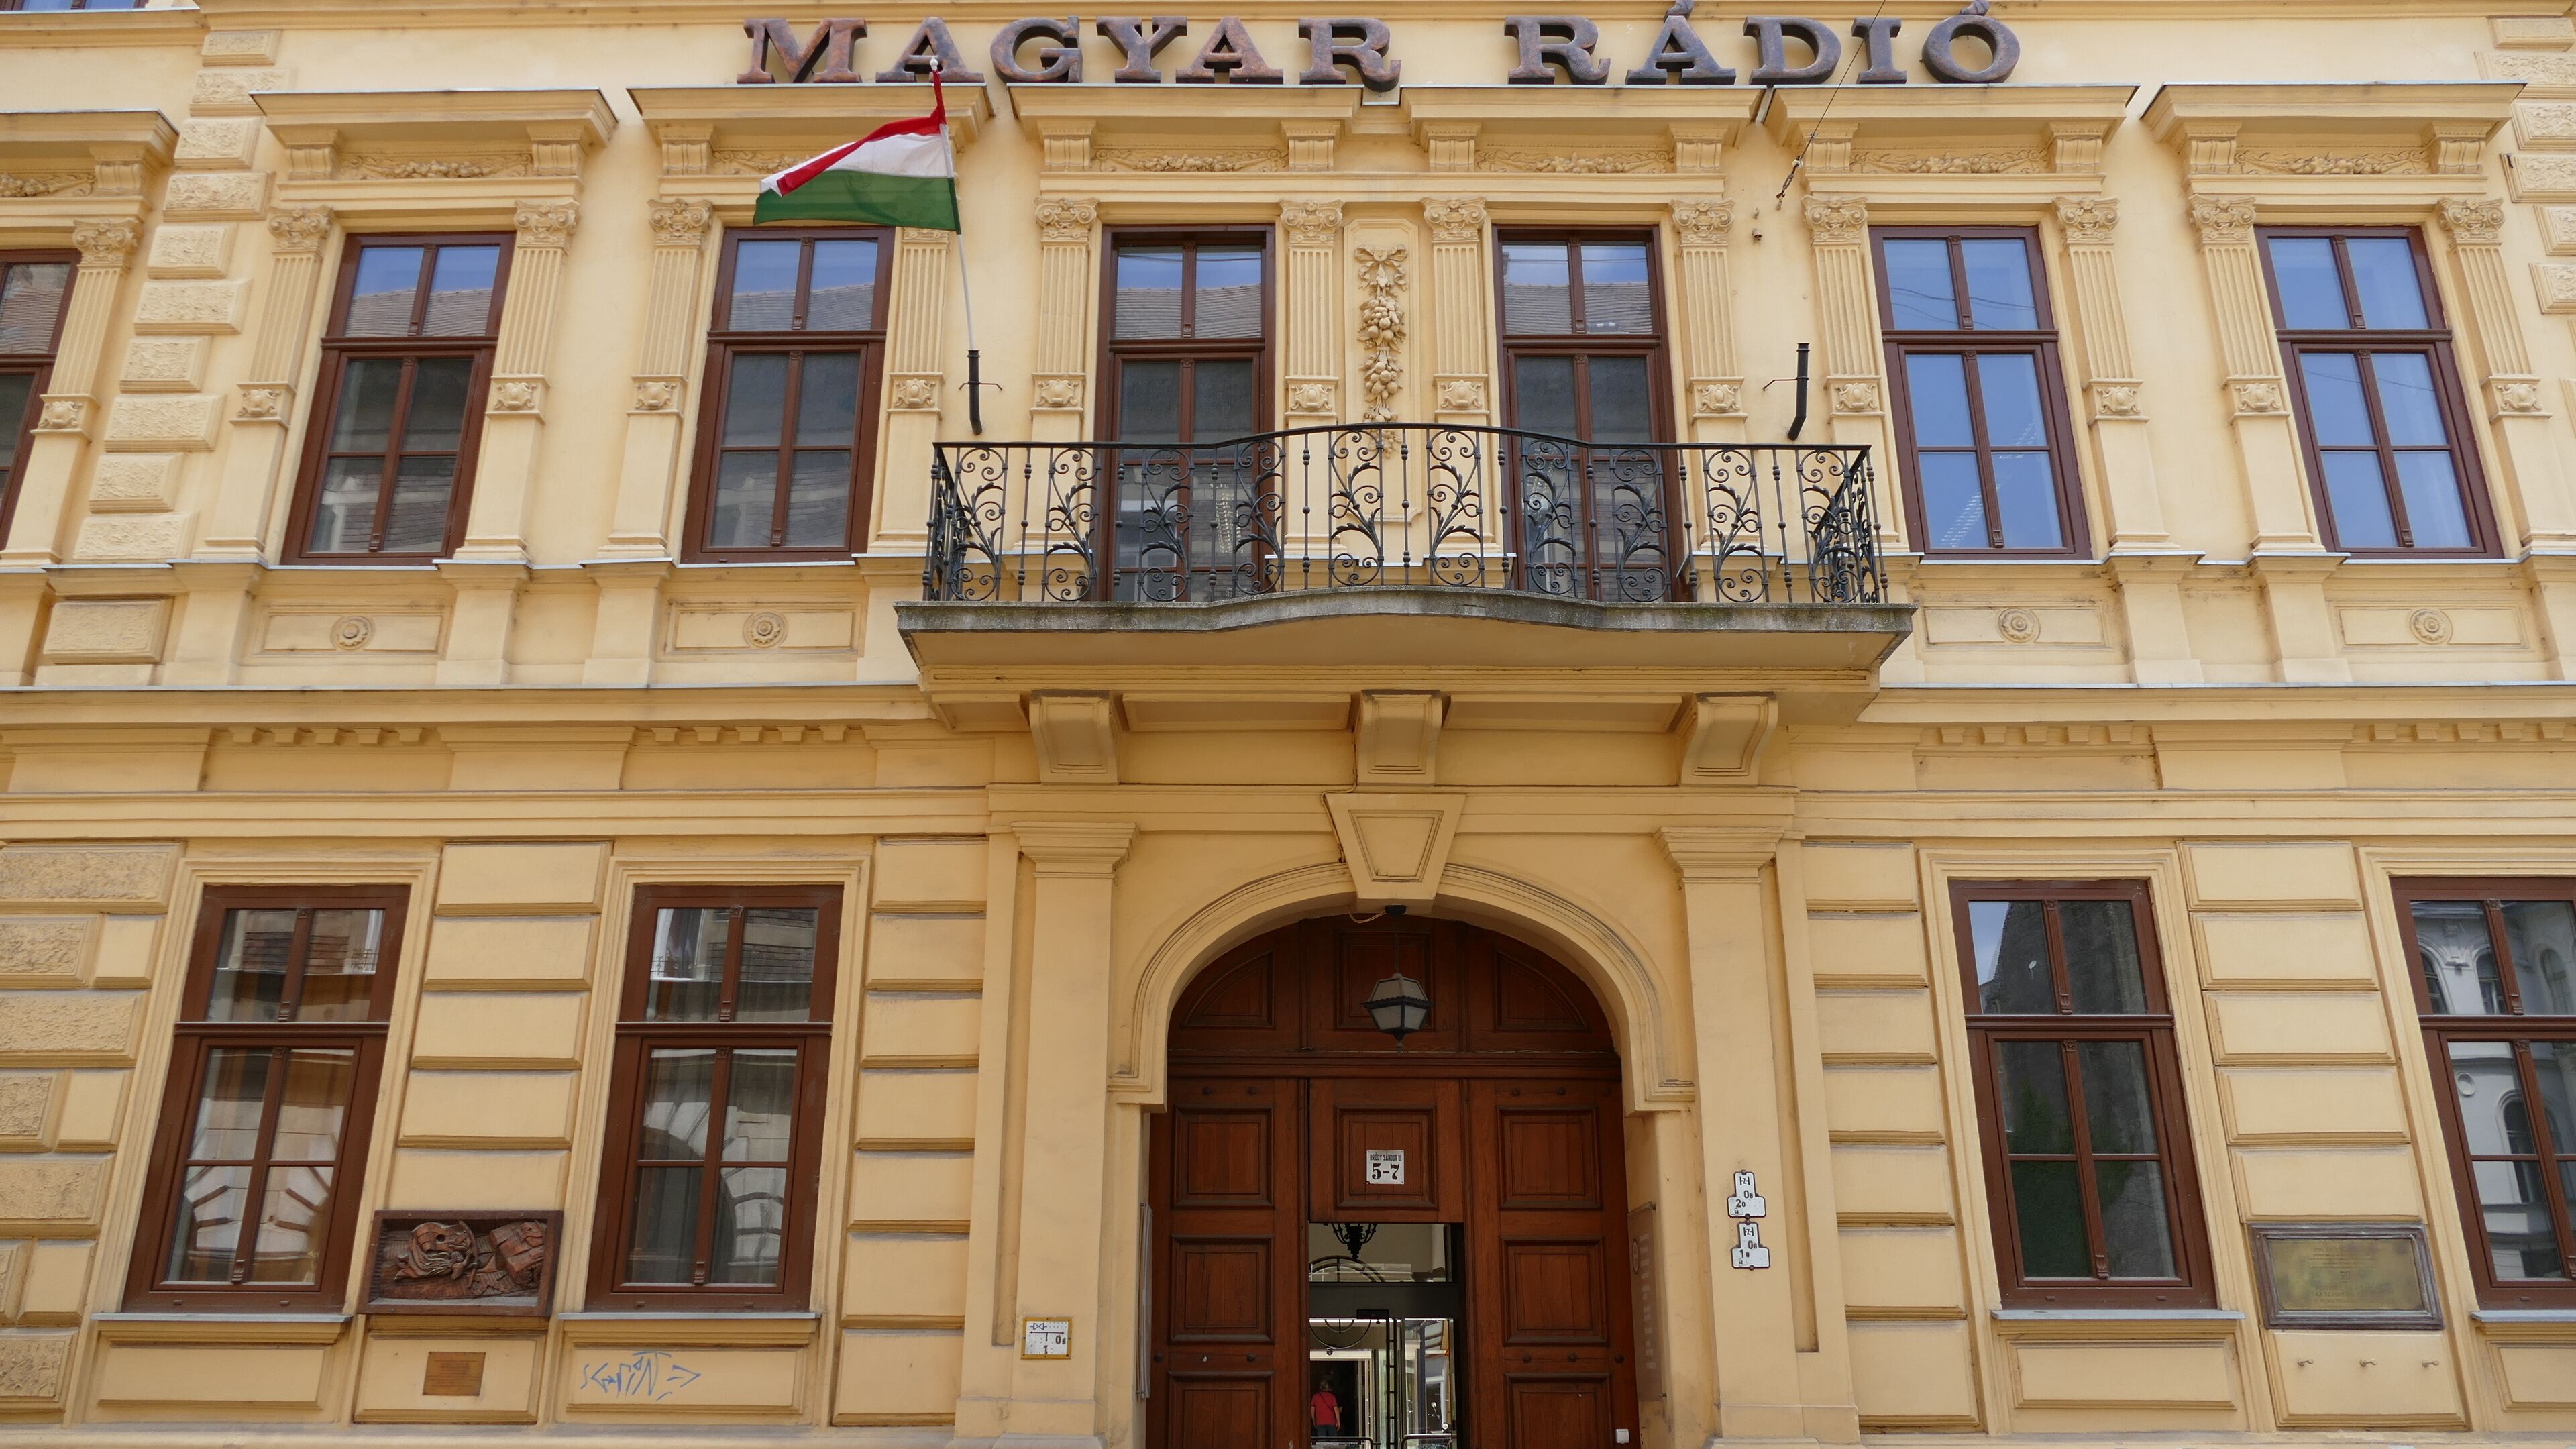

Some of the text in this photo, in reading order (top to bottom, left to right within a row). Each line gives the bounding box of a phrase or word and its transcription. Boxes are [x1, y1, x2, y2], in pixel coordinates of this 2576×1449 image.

[737, 0, 2020, 93] MAGYAR RÁDIÓ
[1370, 1152, 1382, 1161] BRÓDY
[1383, 1152, 1397, 1161] SÁNDOR
[1372, 1163, 1400, 1180] 5-7
